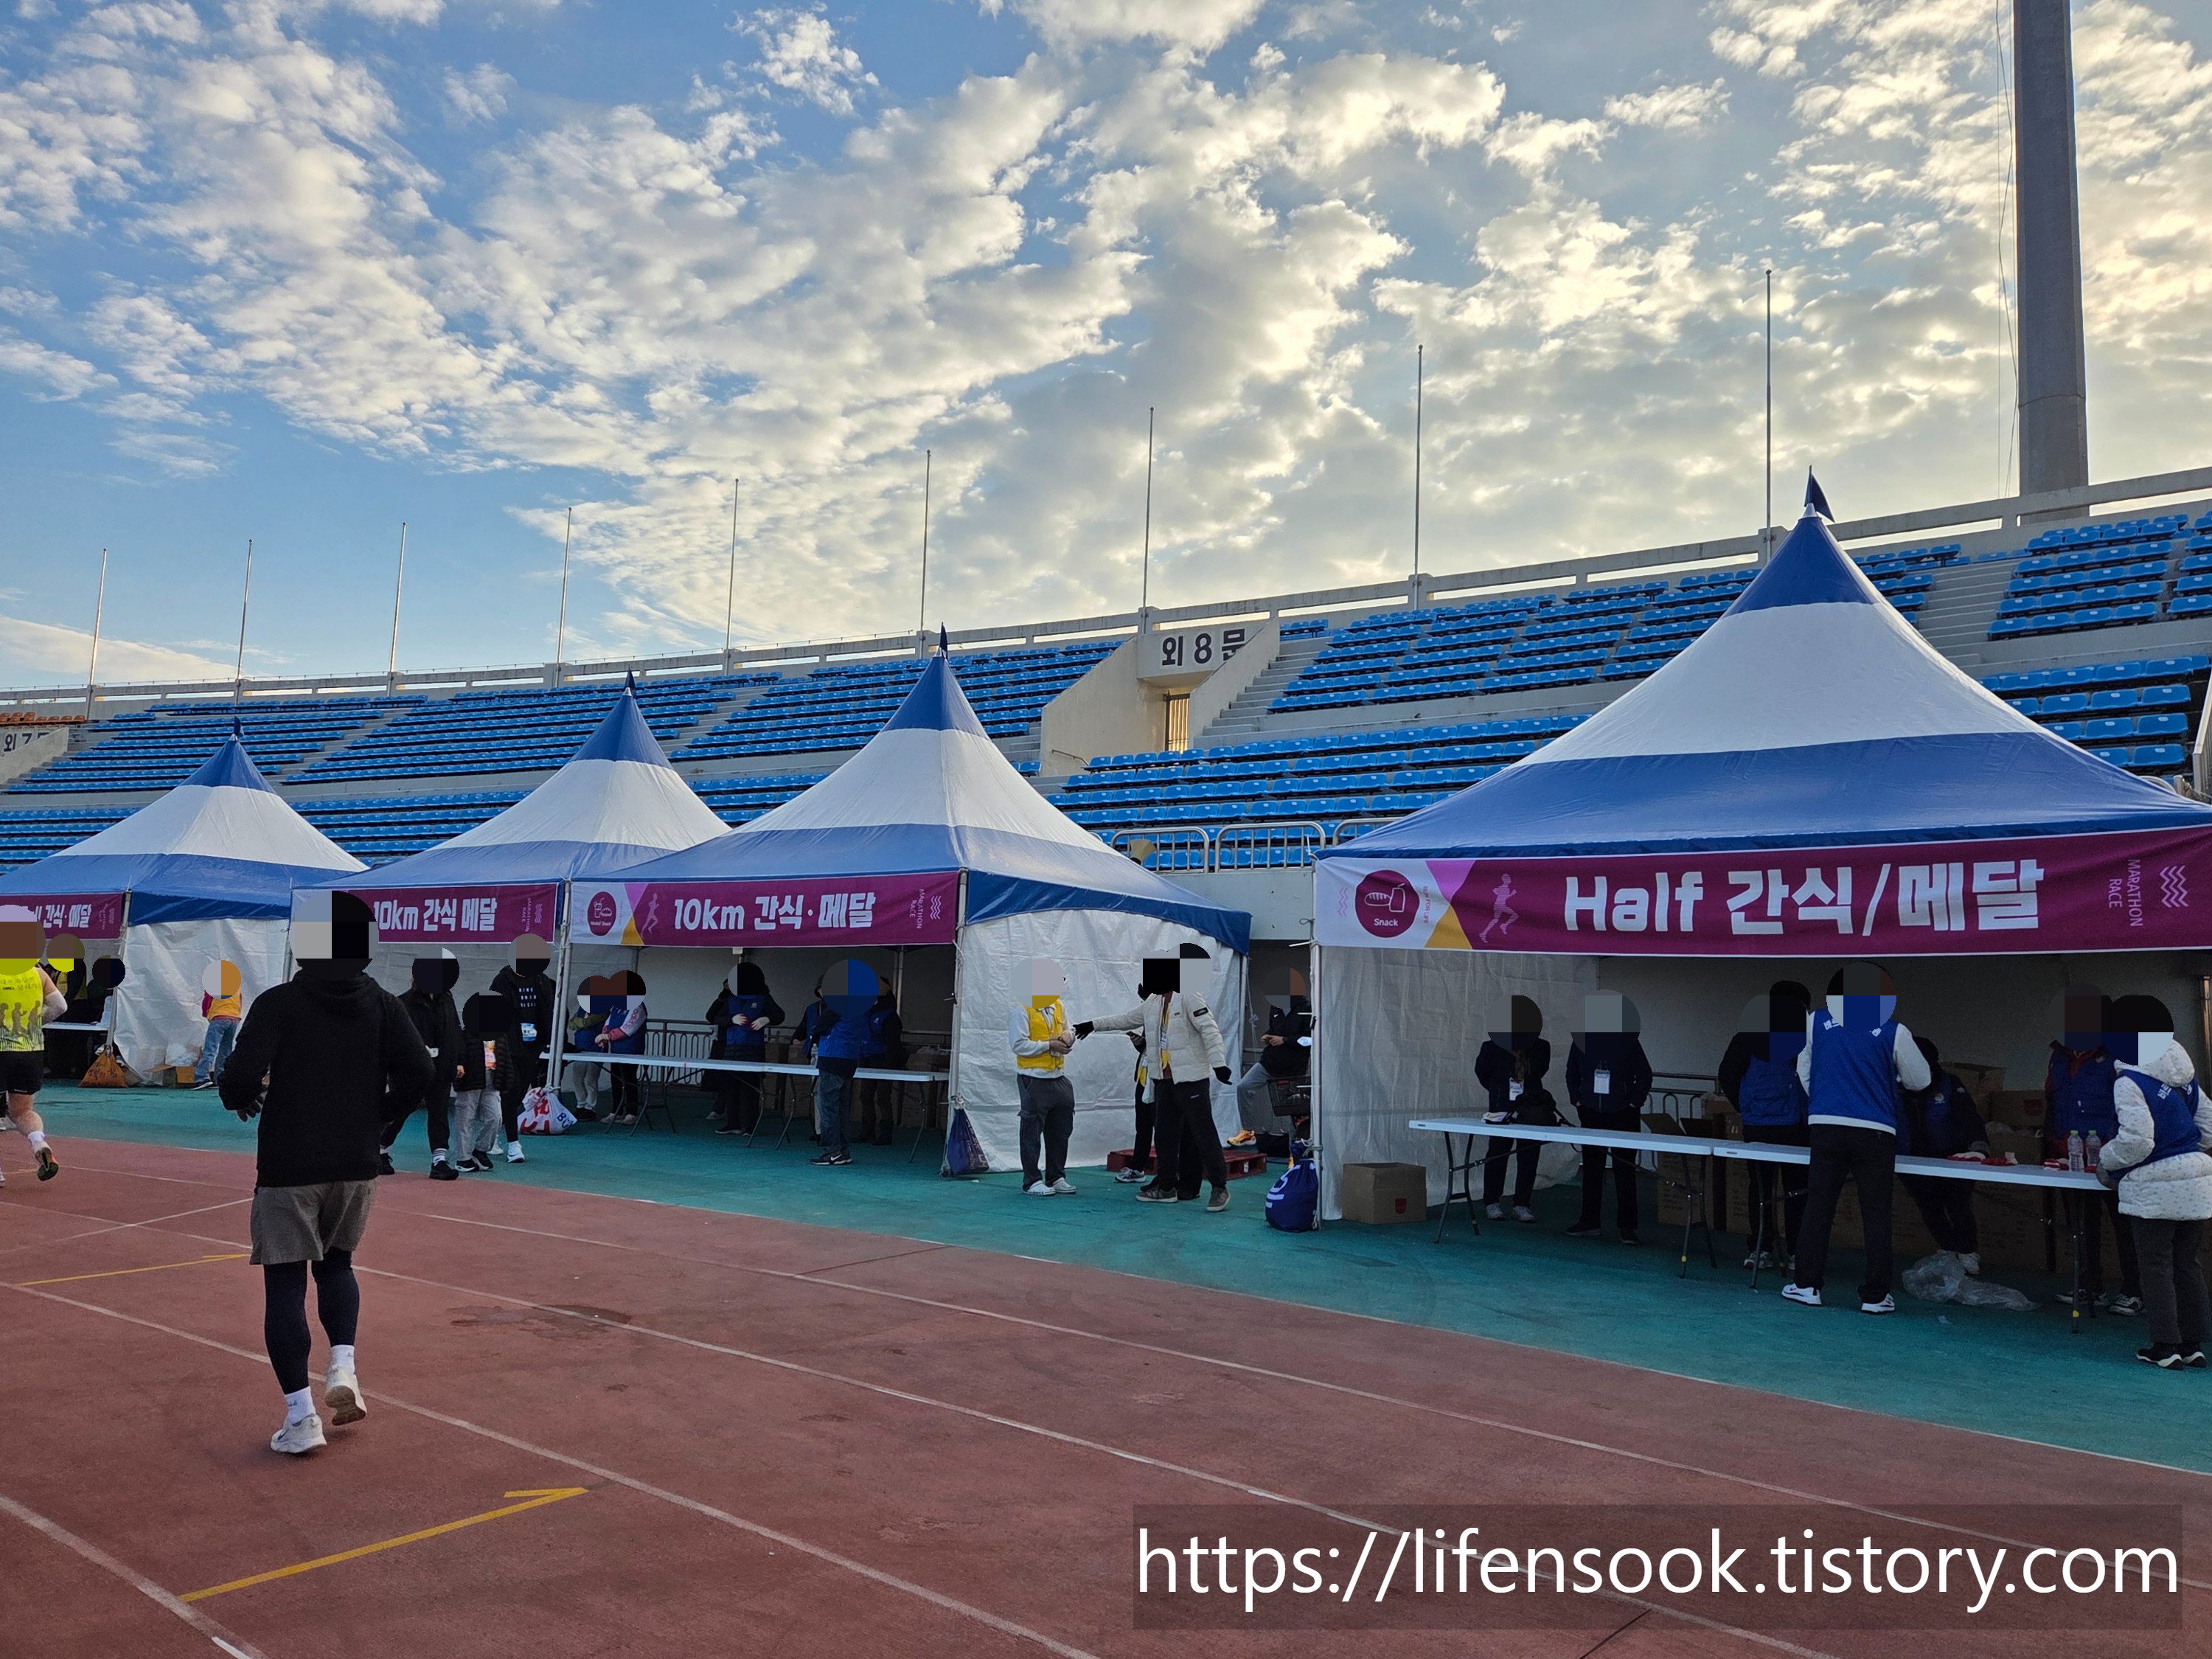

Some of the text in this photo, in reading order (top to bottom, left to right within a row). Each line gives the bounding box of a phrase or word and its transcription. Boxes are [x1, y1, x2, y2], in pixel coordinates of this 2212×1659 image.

[909, 900, 917, 918] RACE
[917, 888, 925, 929] MARATHON
[1565, 871, 1703, 932] Half
[2108, 878, 2122, 908] RACE
[2126, 859, 2143, 927] MARATHON
[374, 897, 497, 931] 10km 간식 메달
[675, 899, 745, 931] 10km
[1374, 918, 1398, 926] Snack
